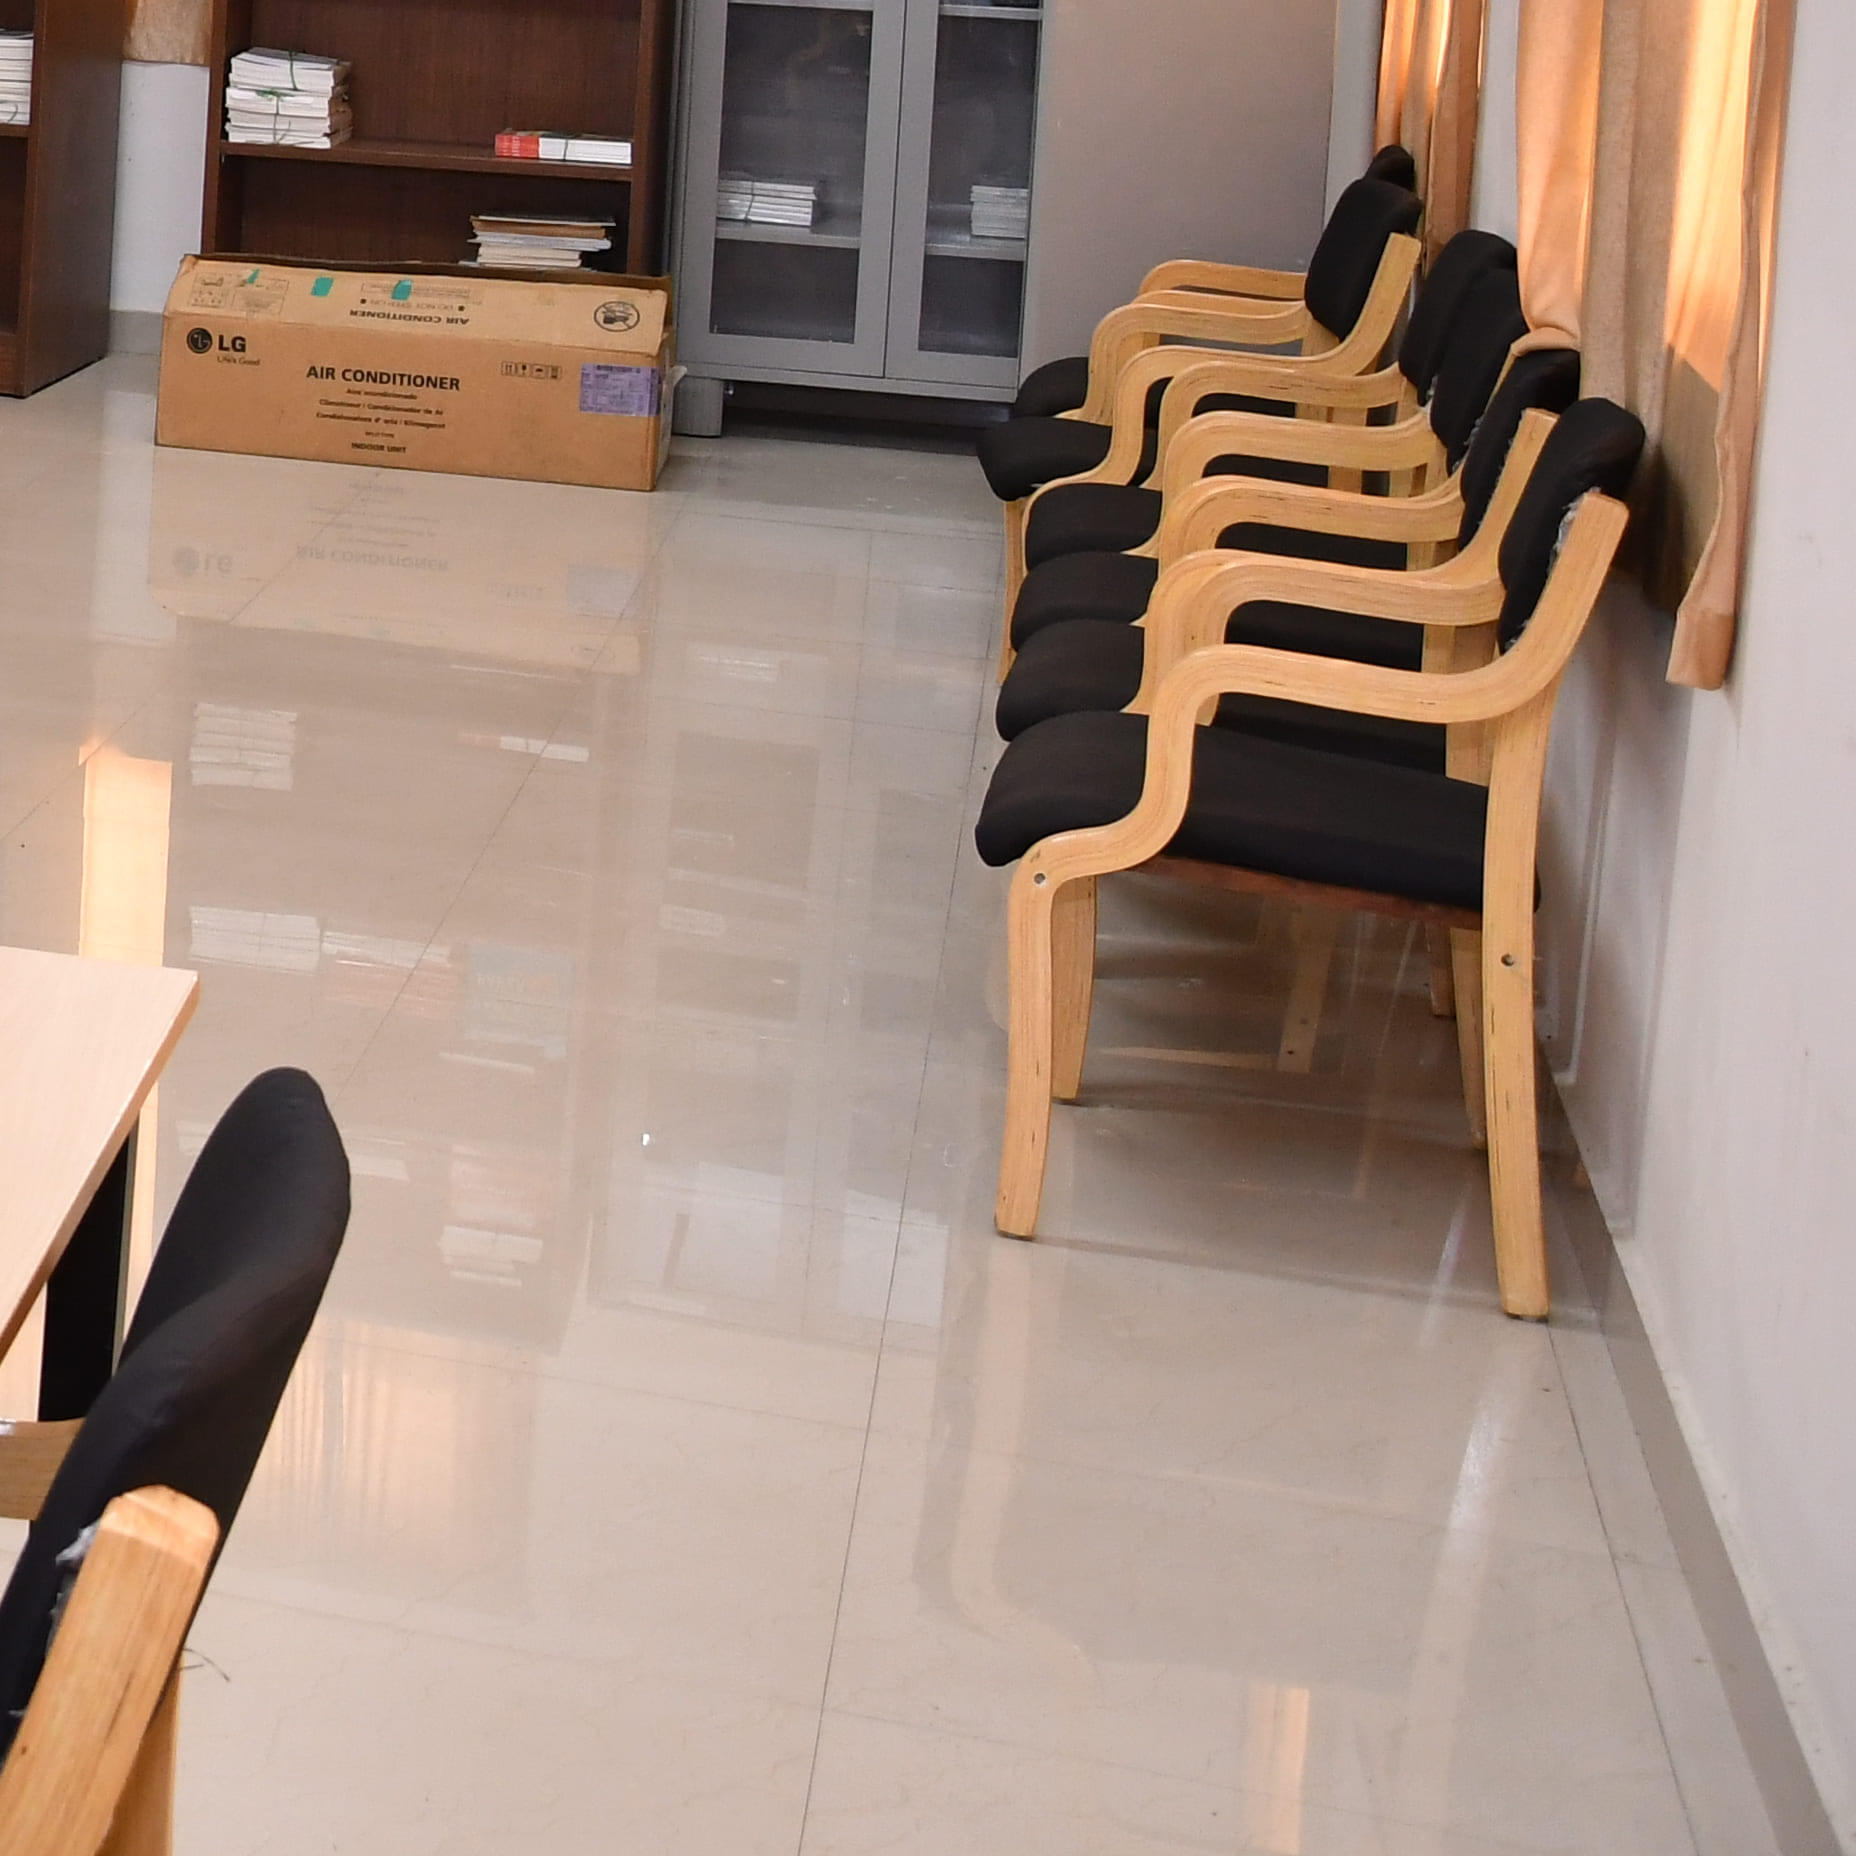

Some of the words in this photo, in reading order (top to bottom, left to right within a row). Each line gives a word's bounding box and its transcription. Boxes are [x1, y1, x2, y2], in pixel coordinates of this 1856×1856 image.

[350, 310, 442, 324] CONDITIONER
[445, 316, 469, 326] AIR
[218, 335, 246, 352] LG
[217, 356, 236, 364] Life's
[239, 358, 260, 366] Good
[306, 366, 337, 380] AIR
[342, 369, 460, 391] CONDITIONER
[351, 441, 384, 452] INDOOR
[386, 444, 406, 454] UNIT
